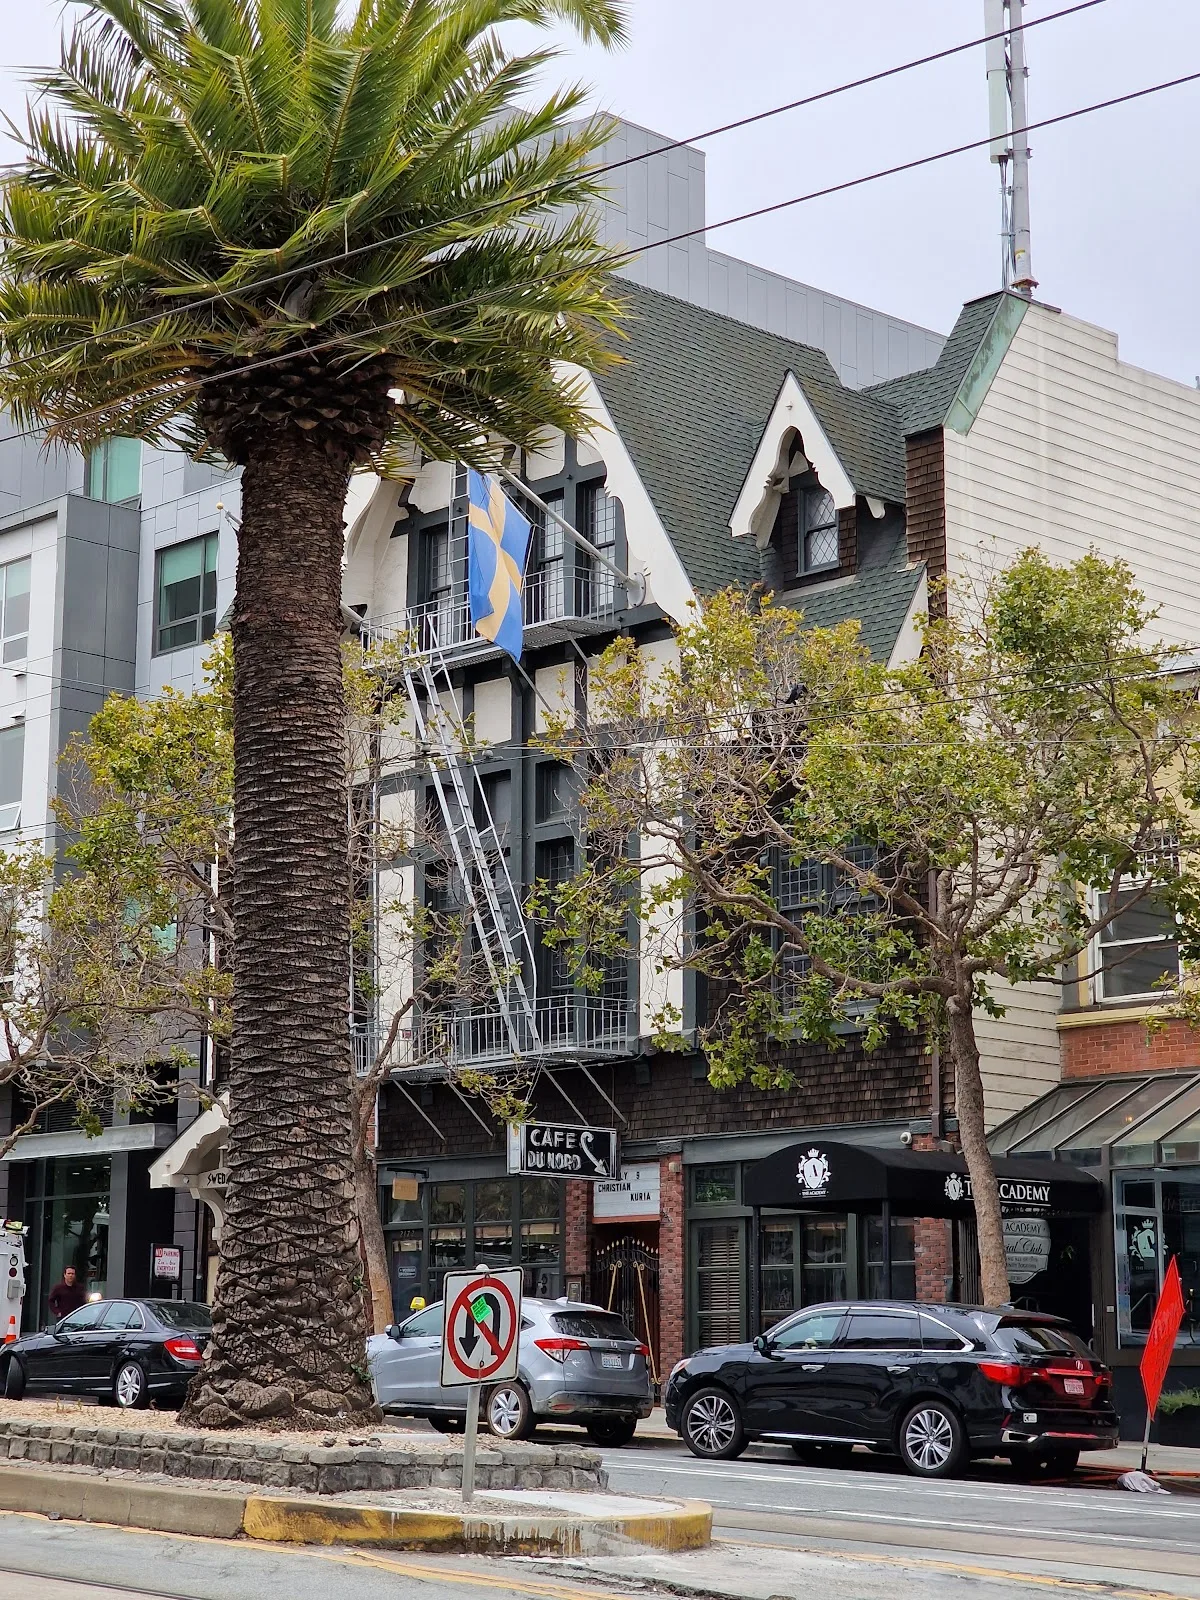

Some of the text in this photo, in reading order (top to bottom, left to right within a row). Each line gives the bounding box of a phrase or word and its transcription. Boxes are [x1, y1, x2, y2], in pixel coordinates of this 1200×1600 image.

[530, 1128, 576, 1149] CAFE
[527, 1150, 581, 1171] DU NORD
[598, 1182, 631, 1193] CHRISTIAN
[998, 1183, 1050, 1202] CADEMY
[630, 1192, 651, 1202] KURIA
[1005, 1222, 1041, 1234] ACADEMY
[156, 1249, 163, 1257] NO
